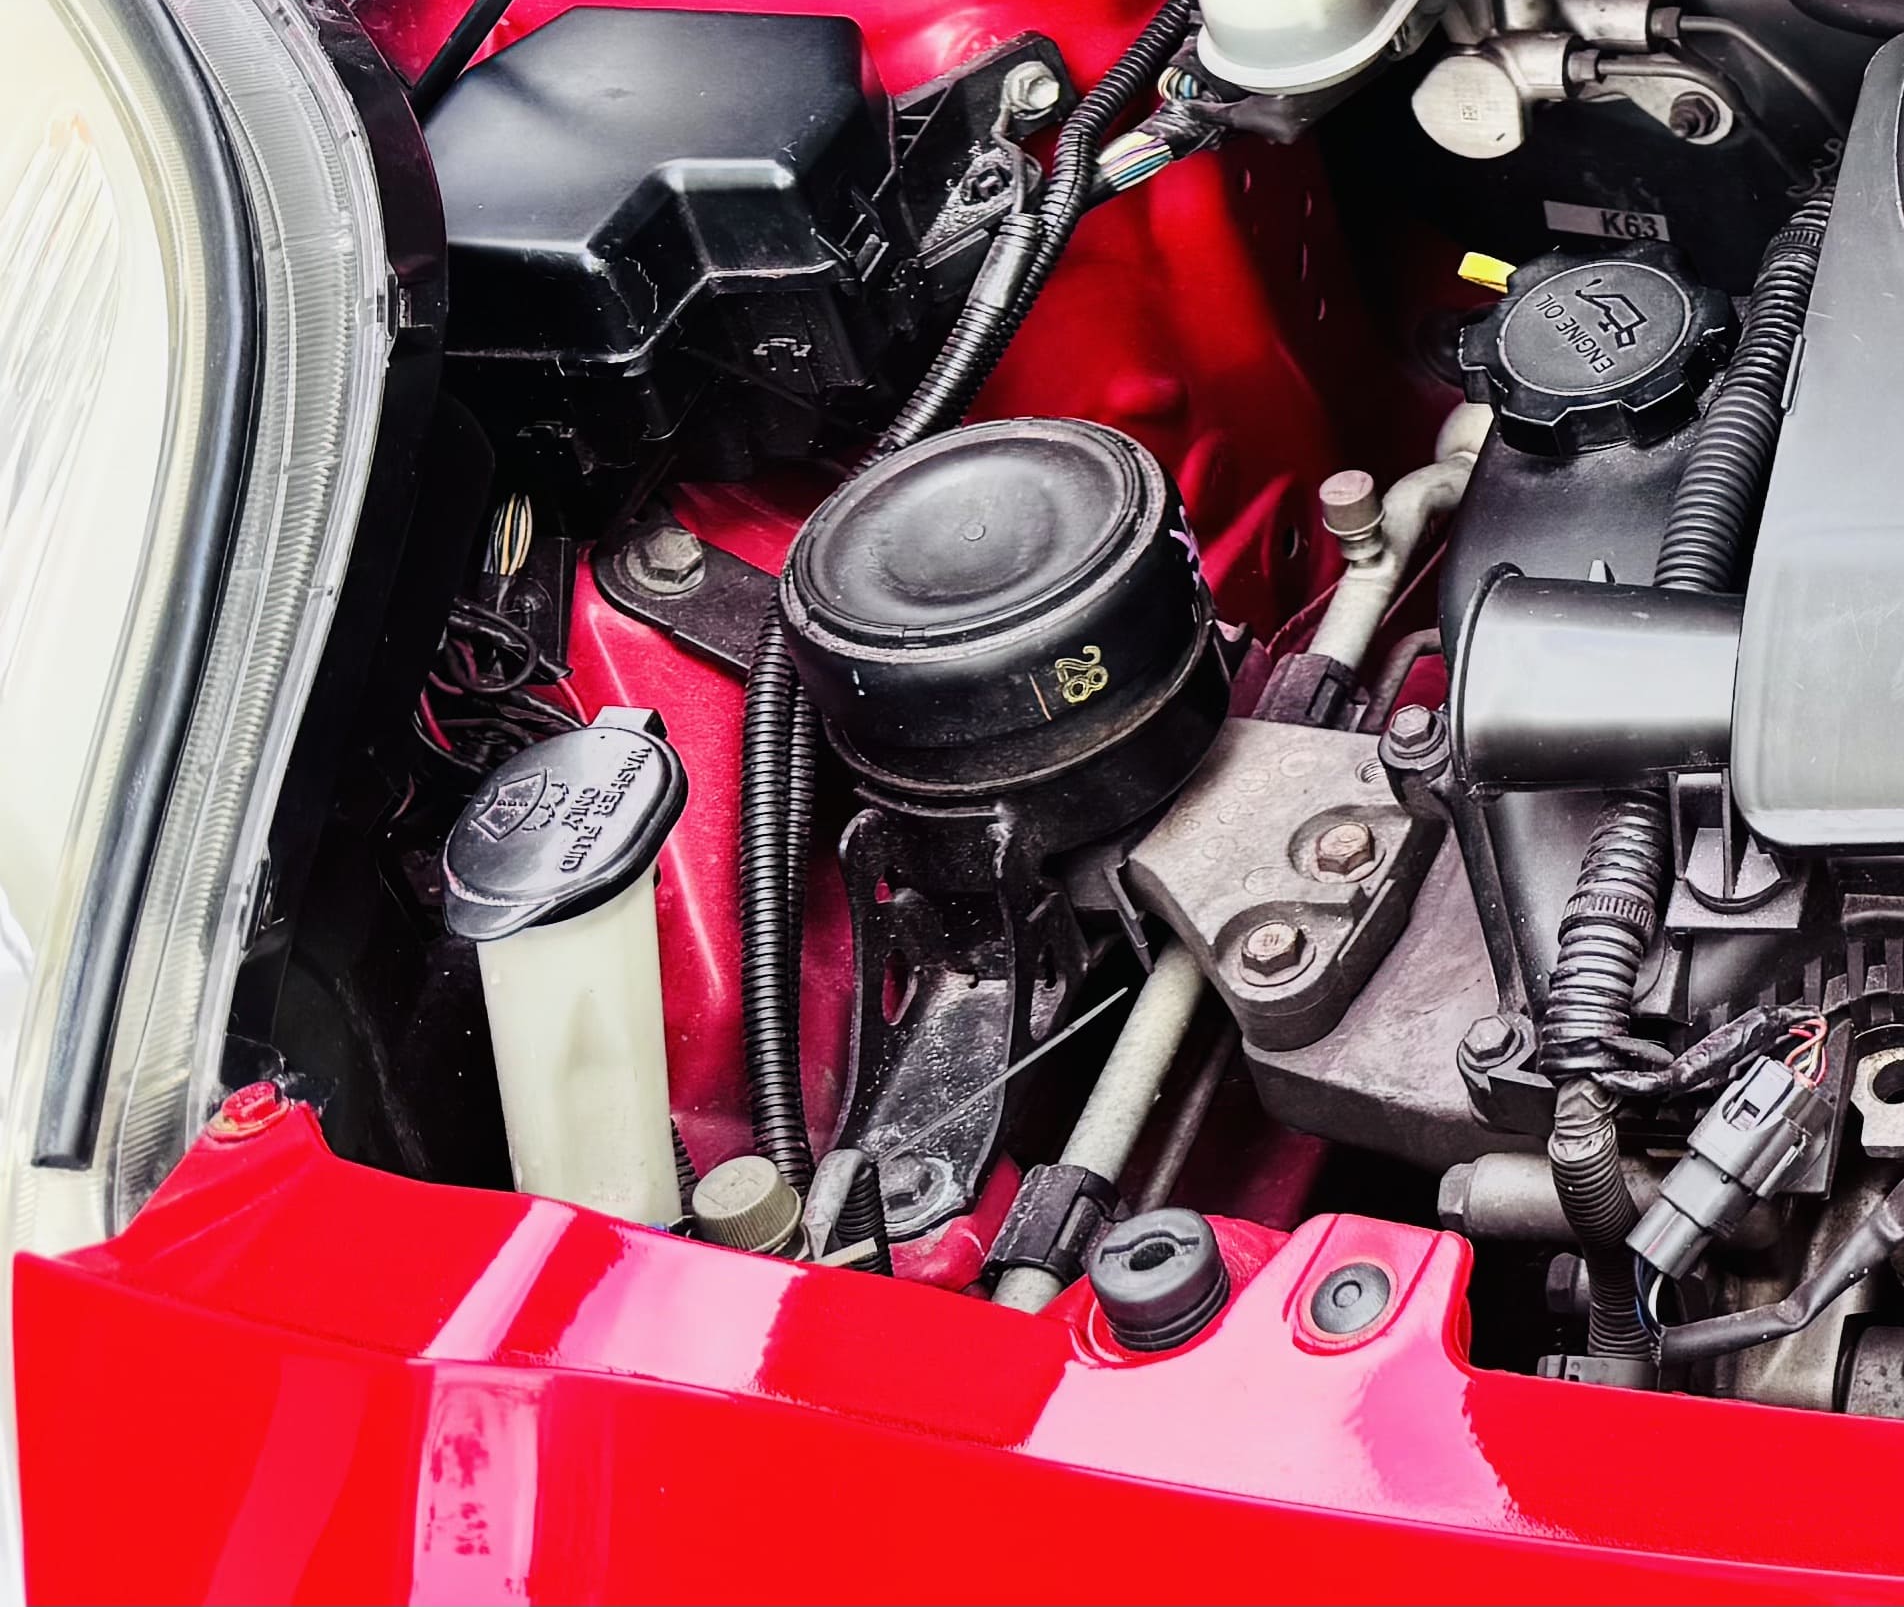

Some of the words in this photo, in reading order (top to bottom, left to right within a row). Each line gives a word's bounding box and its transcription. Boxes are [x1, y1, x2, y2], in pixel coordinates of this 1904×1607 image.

[1600, 210, 1660, 239] K63
[1536, 293, 1566, 320] OIL
[1555, 316, 1616, 375] ENGINE
[1055, 645, 1109, 704] 28
[593, 747, 653, 817] WASHER
[561, 787, 600, 831] ONLY
[559, 826, 602, 872] FLUID
